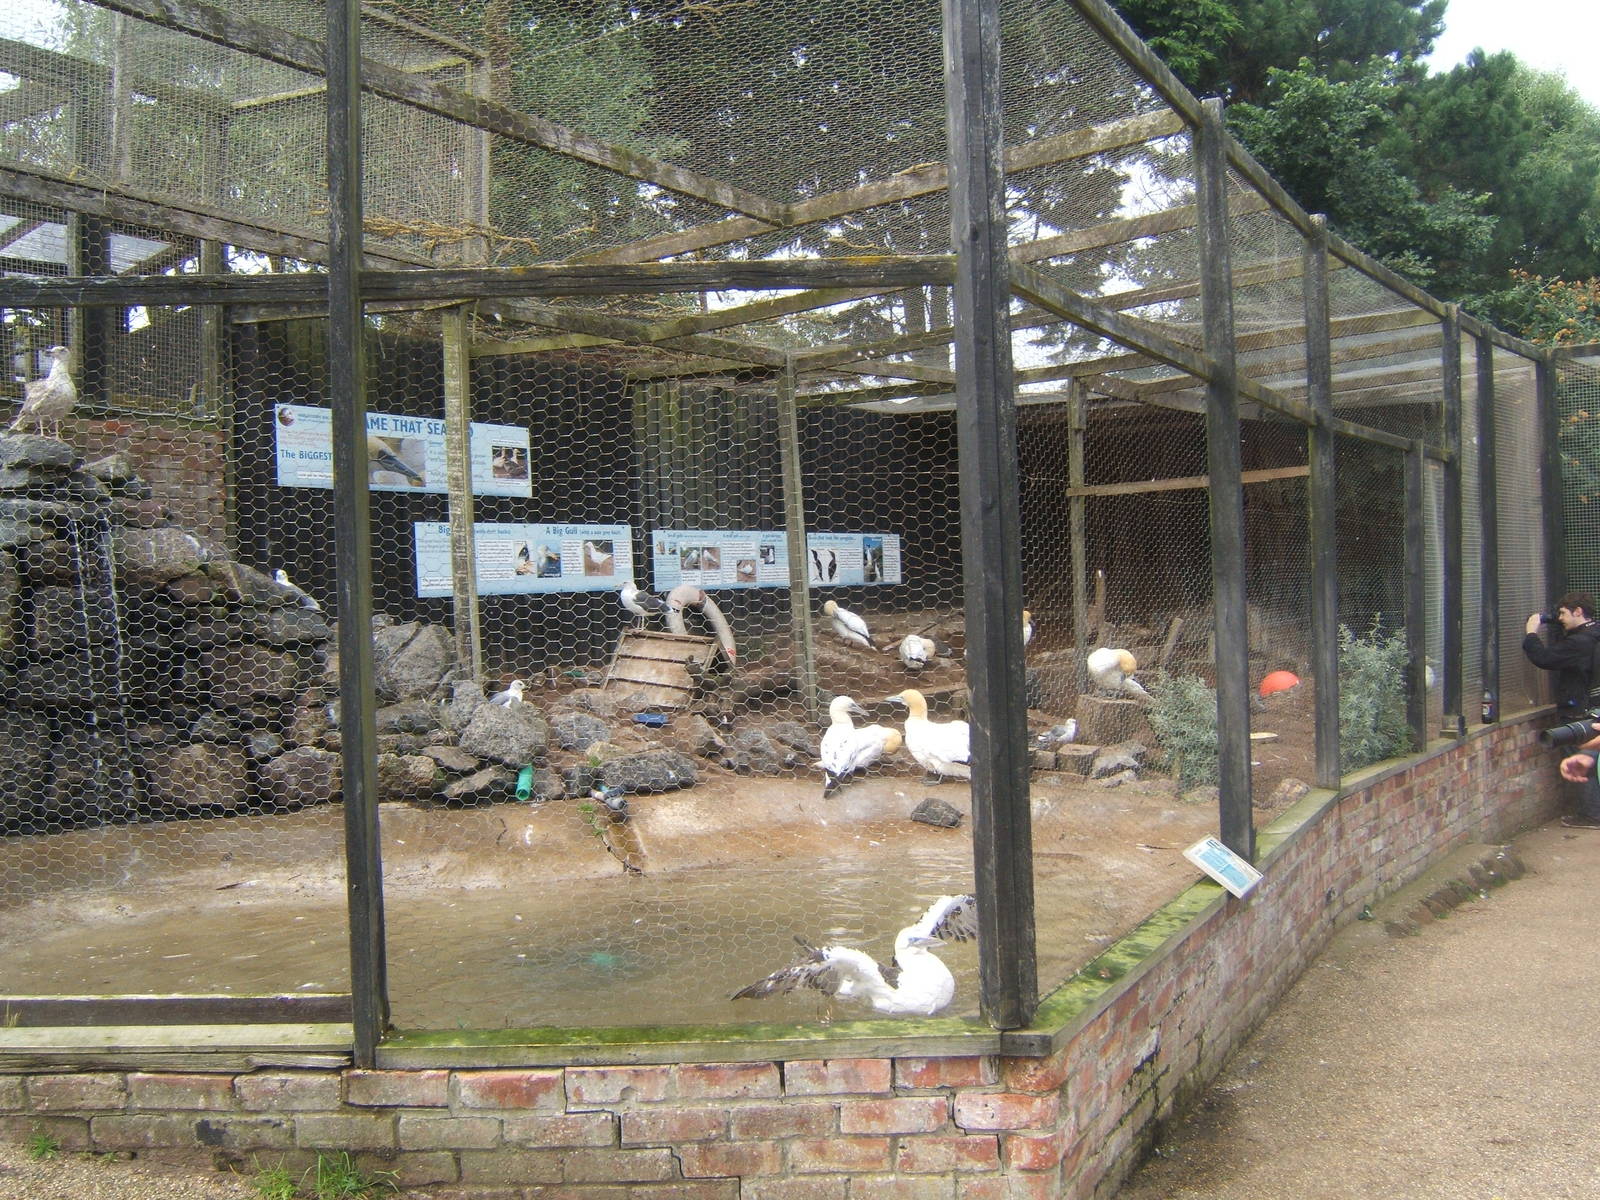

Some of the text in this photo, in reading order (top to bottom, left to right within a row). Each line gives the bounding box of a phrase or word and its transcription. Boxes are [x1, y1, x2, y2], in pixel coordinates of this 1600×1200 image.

[367, 417, 388, 431] ME
[392, 418, 422, 434] THAT
[280, 449, 332, 461] The BIGGEST
[438, 525, 451, 537] Big
[545, 526, 551, 535] A
[552, 526, 563, 537] Big
[565, 526, 578, 535] Gull
